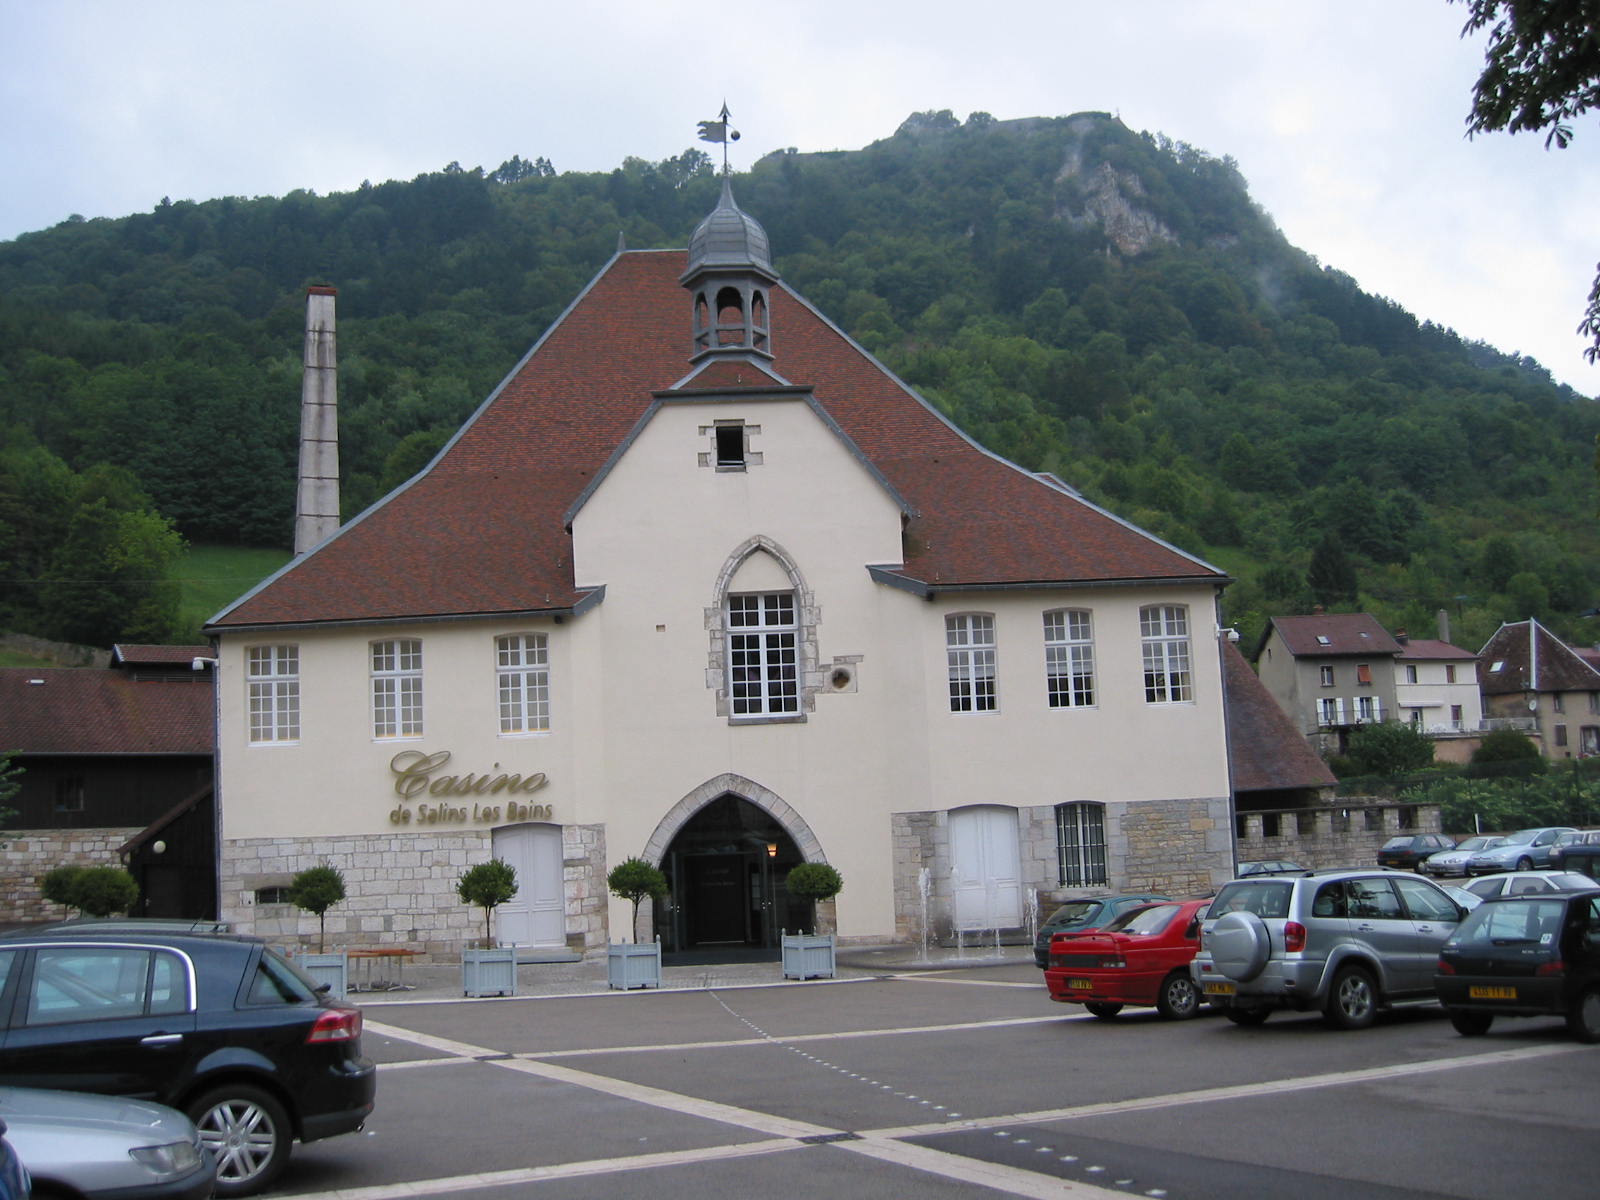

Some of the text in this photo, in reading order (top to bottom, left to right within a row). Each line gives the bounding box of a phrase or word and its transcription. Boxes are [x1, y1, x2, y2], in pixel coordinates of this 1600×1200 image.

[390, 750, 550, 800] Casino
[390, 800, 553, 825] de Salins Les Bains
